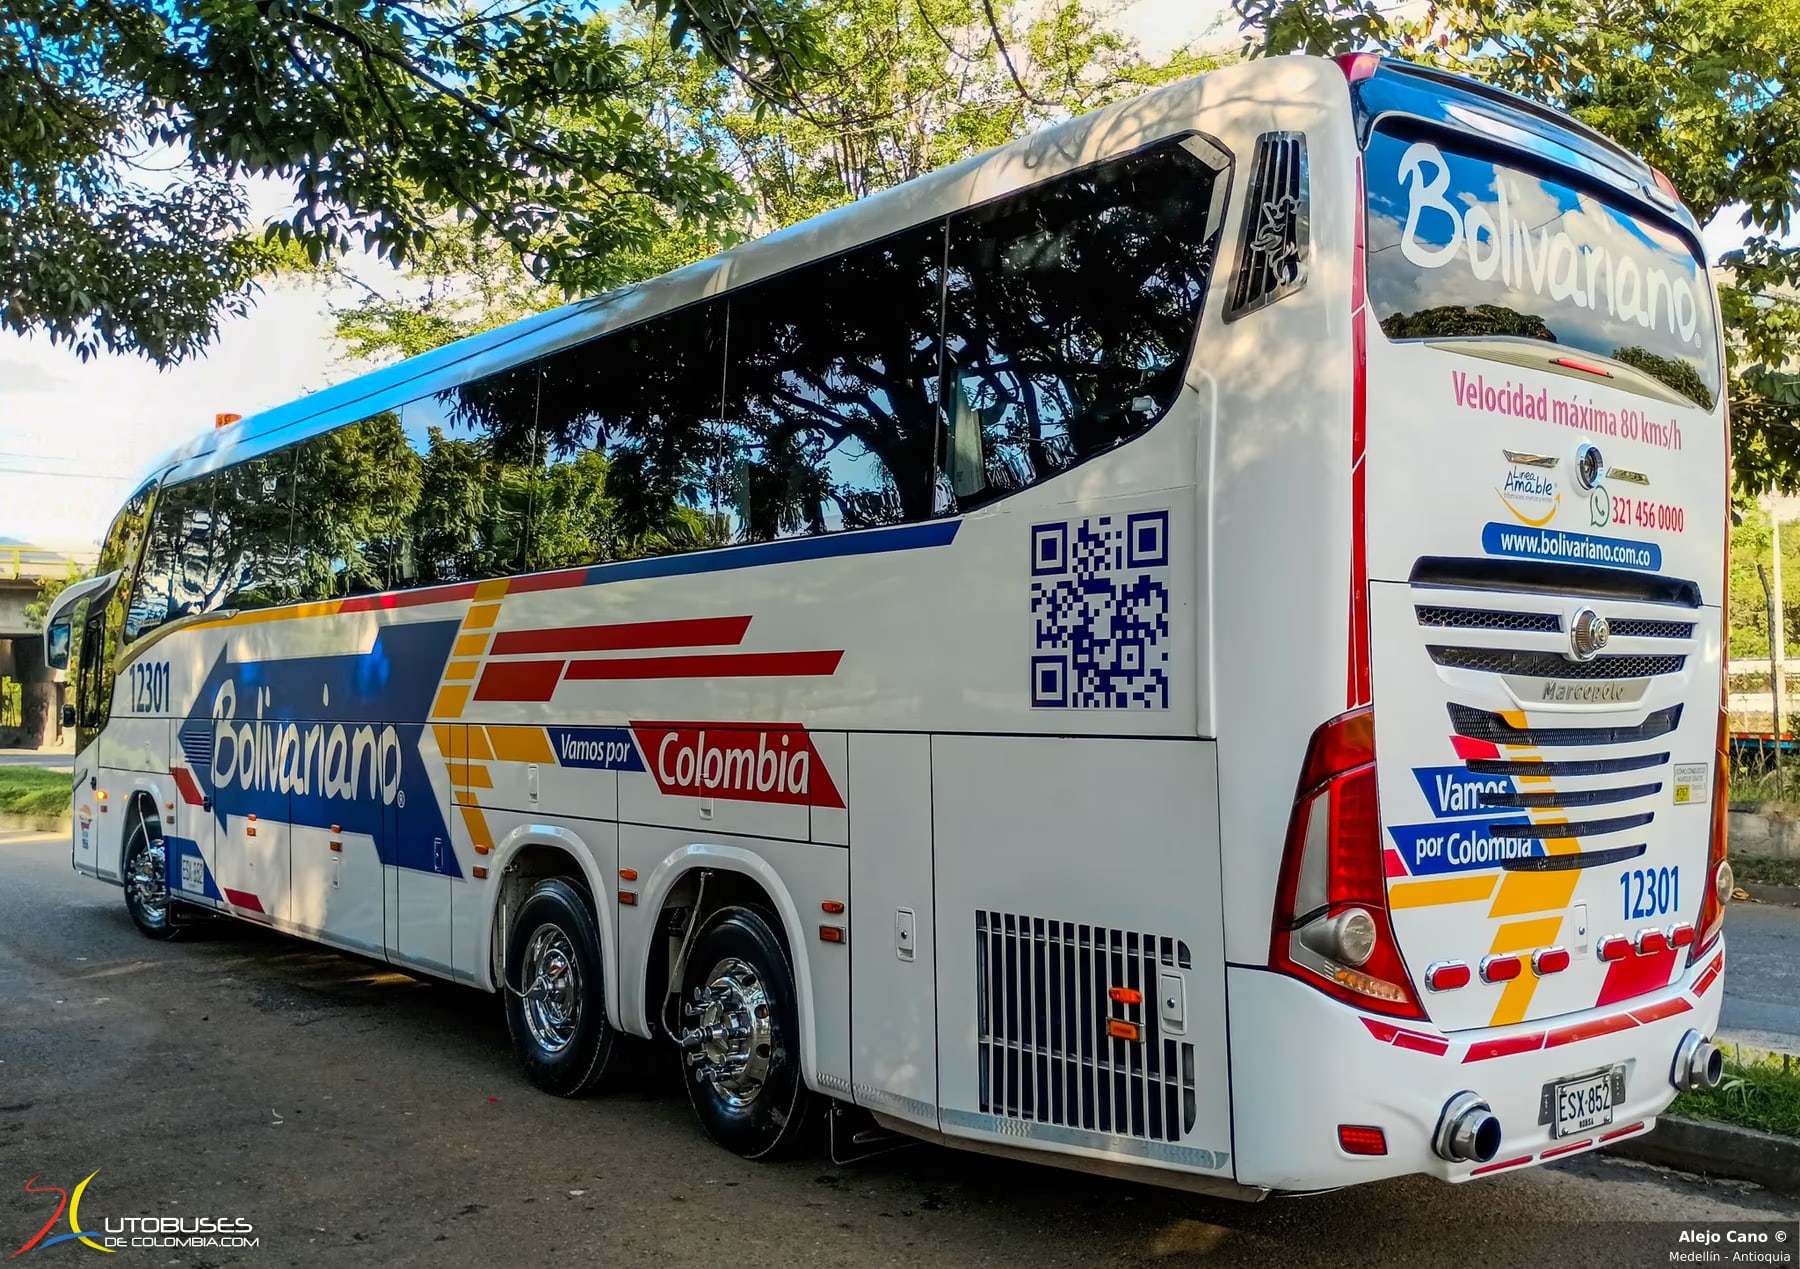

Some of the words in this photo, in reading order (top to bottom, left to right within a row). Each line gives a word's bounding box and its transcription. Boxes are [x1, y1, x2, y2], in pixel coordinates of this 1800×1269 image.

[1398, 143, 1697, 343] Bolivariano
[1452, 371, 1548, 422] Velocidad
[1552, 394, 1617, 436] máxima
[1620, 408, 1638, 441] 80
[1641, 411, 1682, 450] kms/h
[1504, 471, 1553, 496] Amable
[1612, 496, 1631, 525] 321
[1635, 501, 1655, 529] 456
[1658, 505, 1684, 533] 0000
[1501, 531, 1650, 567] www.bolivariano.com.co
[130, 661, 170, 713] 12301
[1542, 681, 1624, 702] Marcopolo
[211, 679, 402, 806] Bolivariano
[561, 733, 603, 761] Vamos
[605, 740, 630, 768] por
[658, 731, 810, 795] Colombia
[1416, 836, 1444, 865] por
[1447, 830, 1532, 865] Colombia
[1620, 866, 1680, 921] 12301
